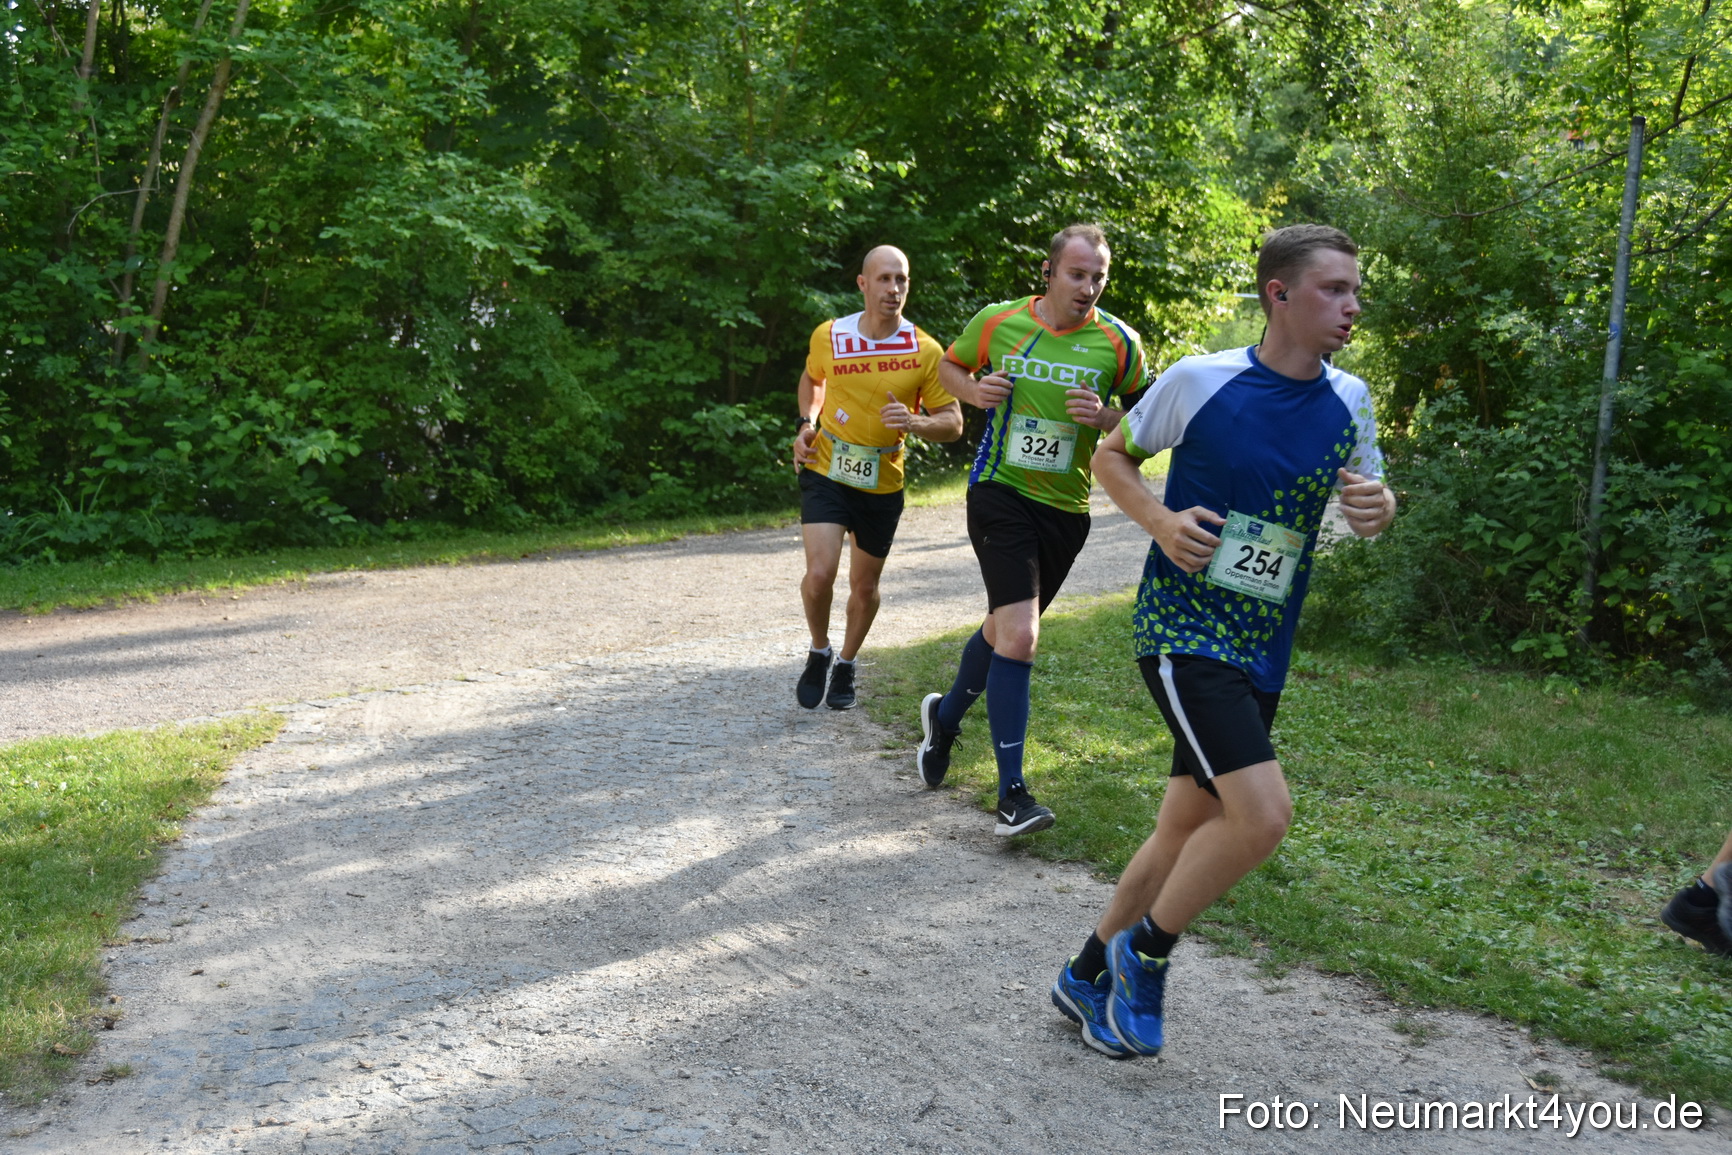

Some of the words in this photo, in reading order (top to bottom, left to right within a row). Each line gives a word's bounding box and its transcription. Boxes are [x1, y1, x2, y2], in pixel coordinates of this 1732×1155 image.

[833, 362, 872, 376] MAX
[877, 358, 922, 372] BÖGL
[1002, 354, 1103, 391] BOCK
[1021, 435, 1060, 458] 324
[837, 455, 872, 477] 1548
[1233, 544, 1284, 580] 254
[1225, 568, 1263, 584] Oppermann
[1262, 579, 1280, 590] Simon
